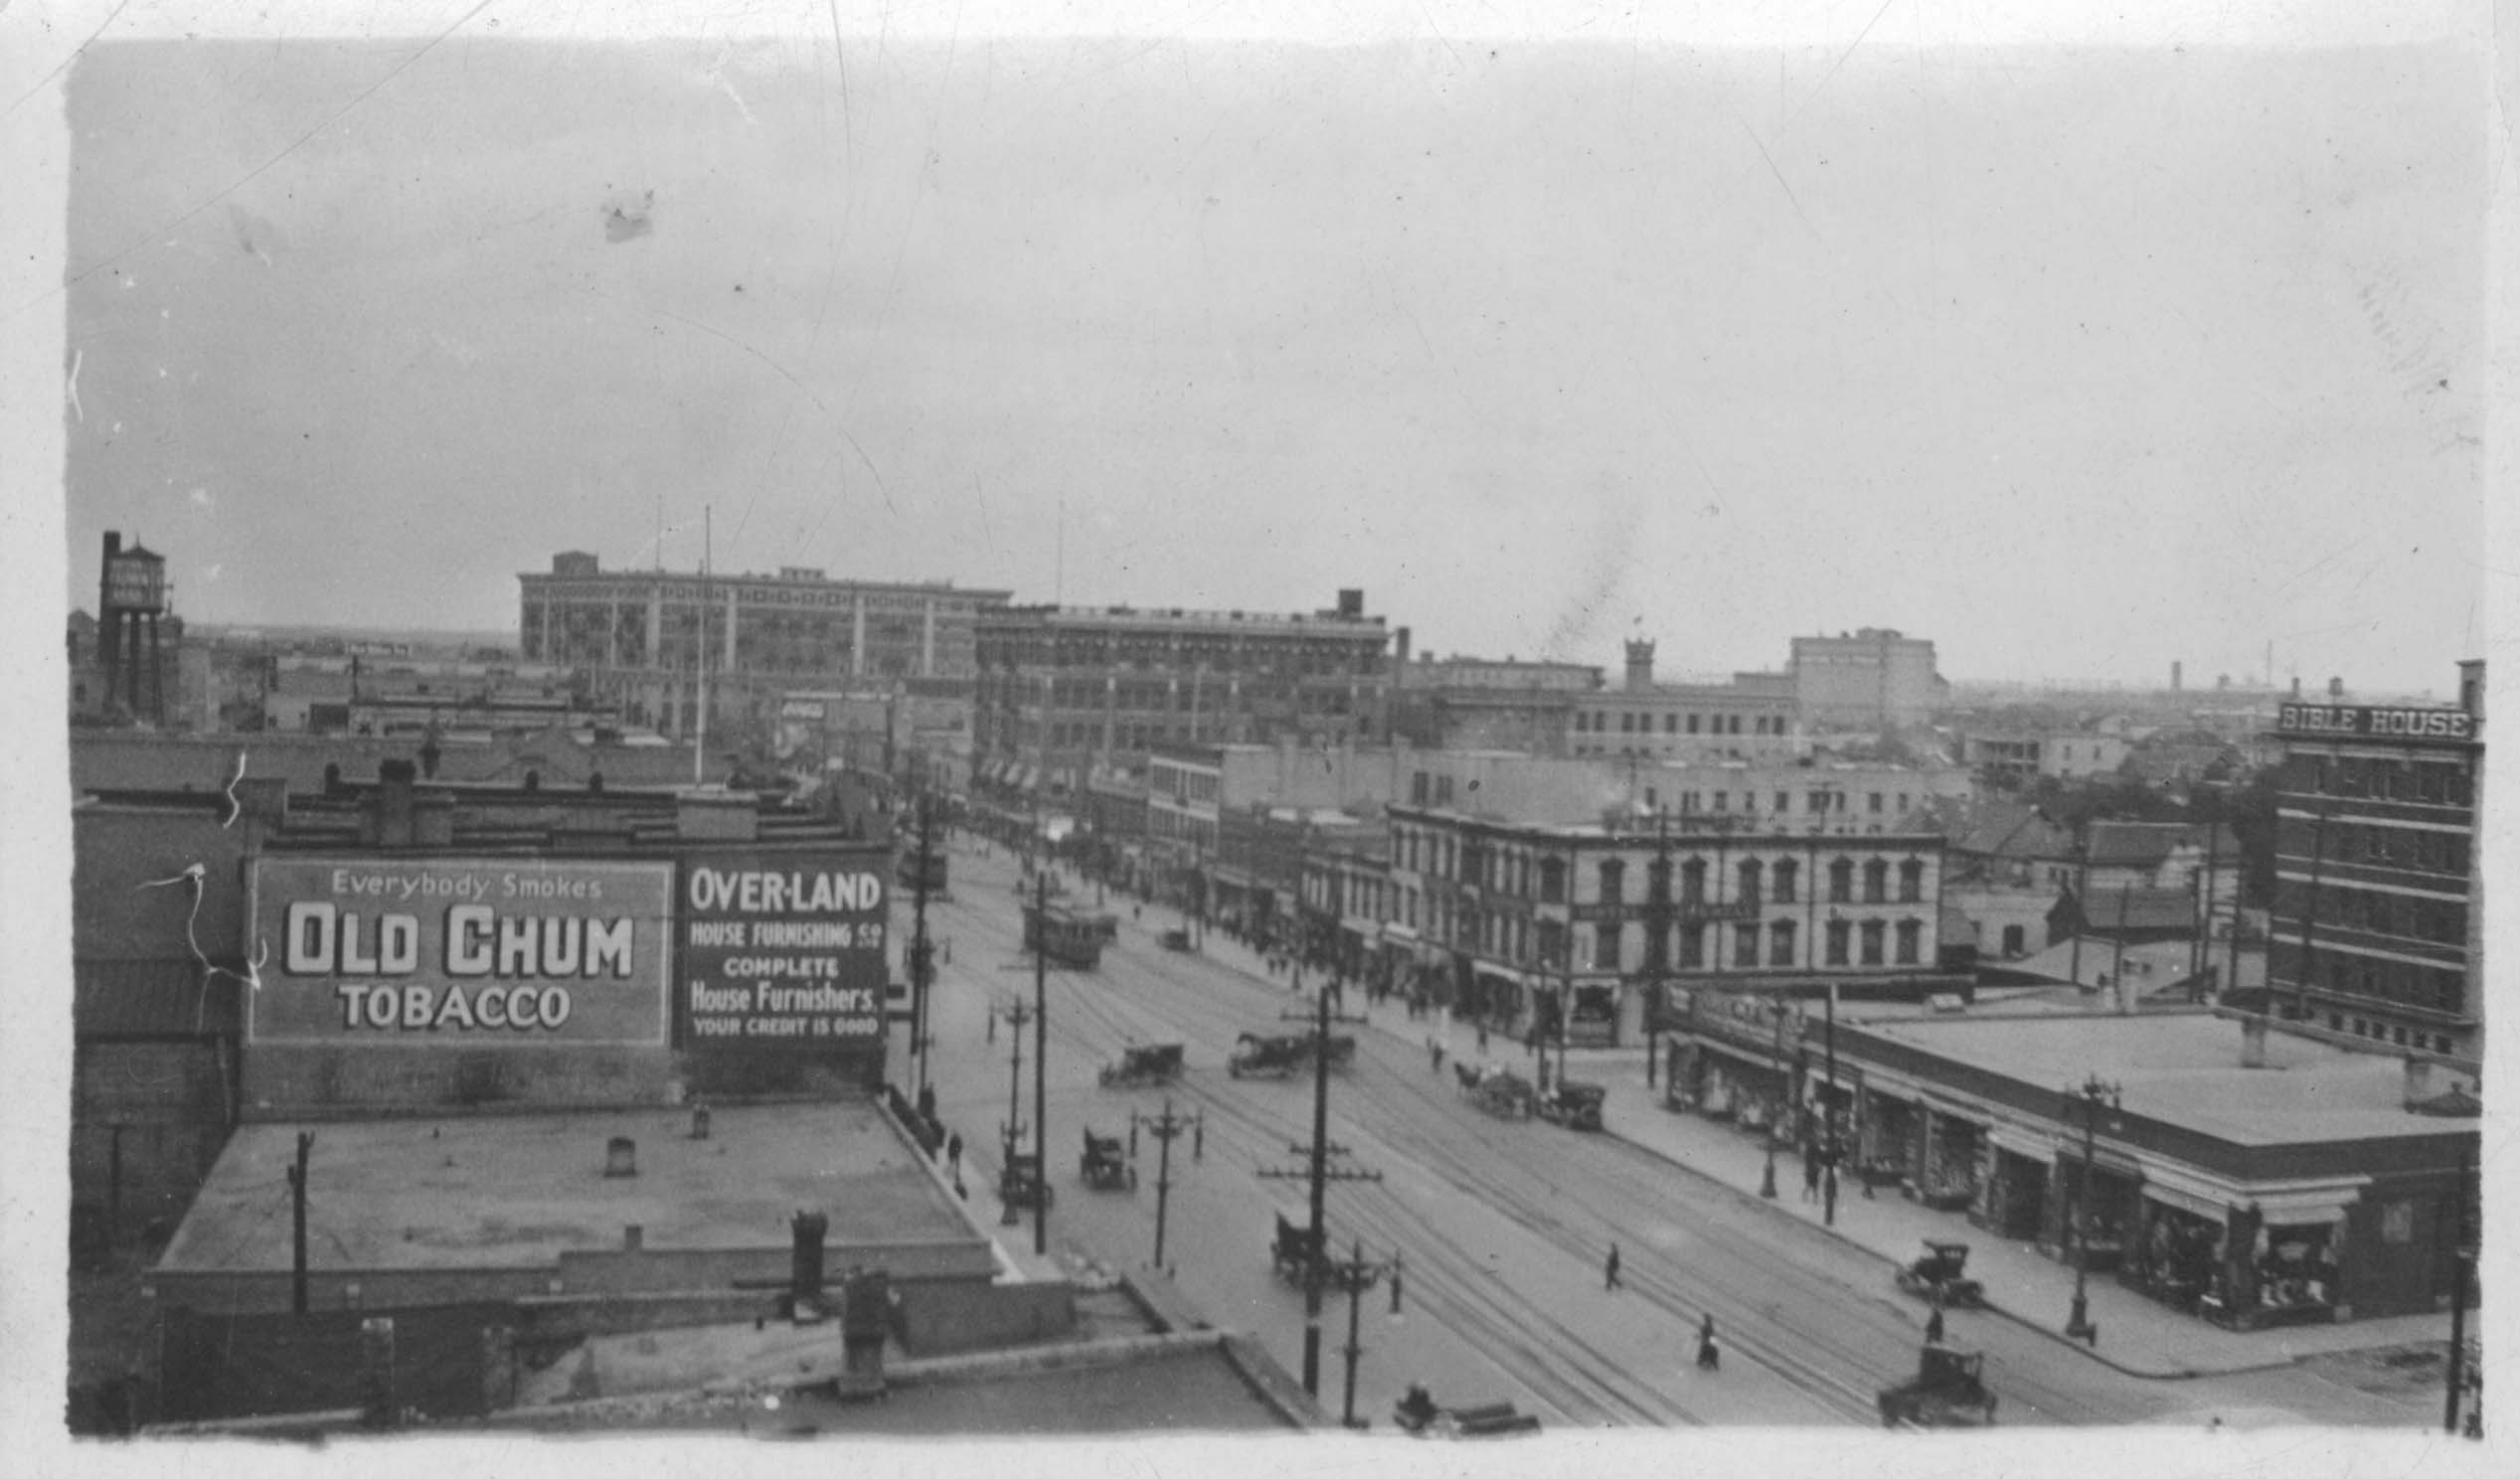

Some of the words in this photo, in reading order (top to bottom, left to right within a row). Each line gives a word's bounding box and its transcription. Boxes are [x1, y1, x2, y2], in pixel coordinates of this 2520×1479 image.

[2281, 707, 2358, 732] BIBLE
[2370, 710, 2470, 738] HOUSE
[332, 869, 491, 902] Everybody
[503, 873, 603, 899] Smokes
[287, 902, 420, 974] OLD
[447, 904, 634, 977] CHUM
[690, 920, 746, 947] HOUSE
[753, 920, 853, 948] FURNISHING
[723, 955, 840, 979] COMPLETE
[339, 984, 572, 1028] TOBACCO
[691, 980, 752, 1013] House
[694, 1017, 742, 1037] YOUR
[747, 1017, 809, 1036] CREDIT
[812, 1017, 830, 1036] IS
[833, 1017, 880, 1036] GOOD
